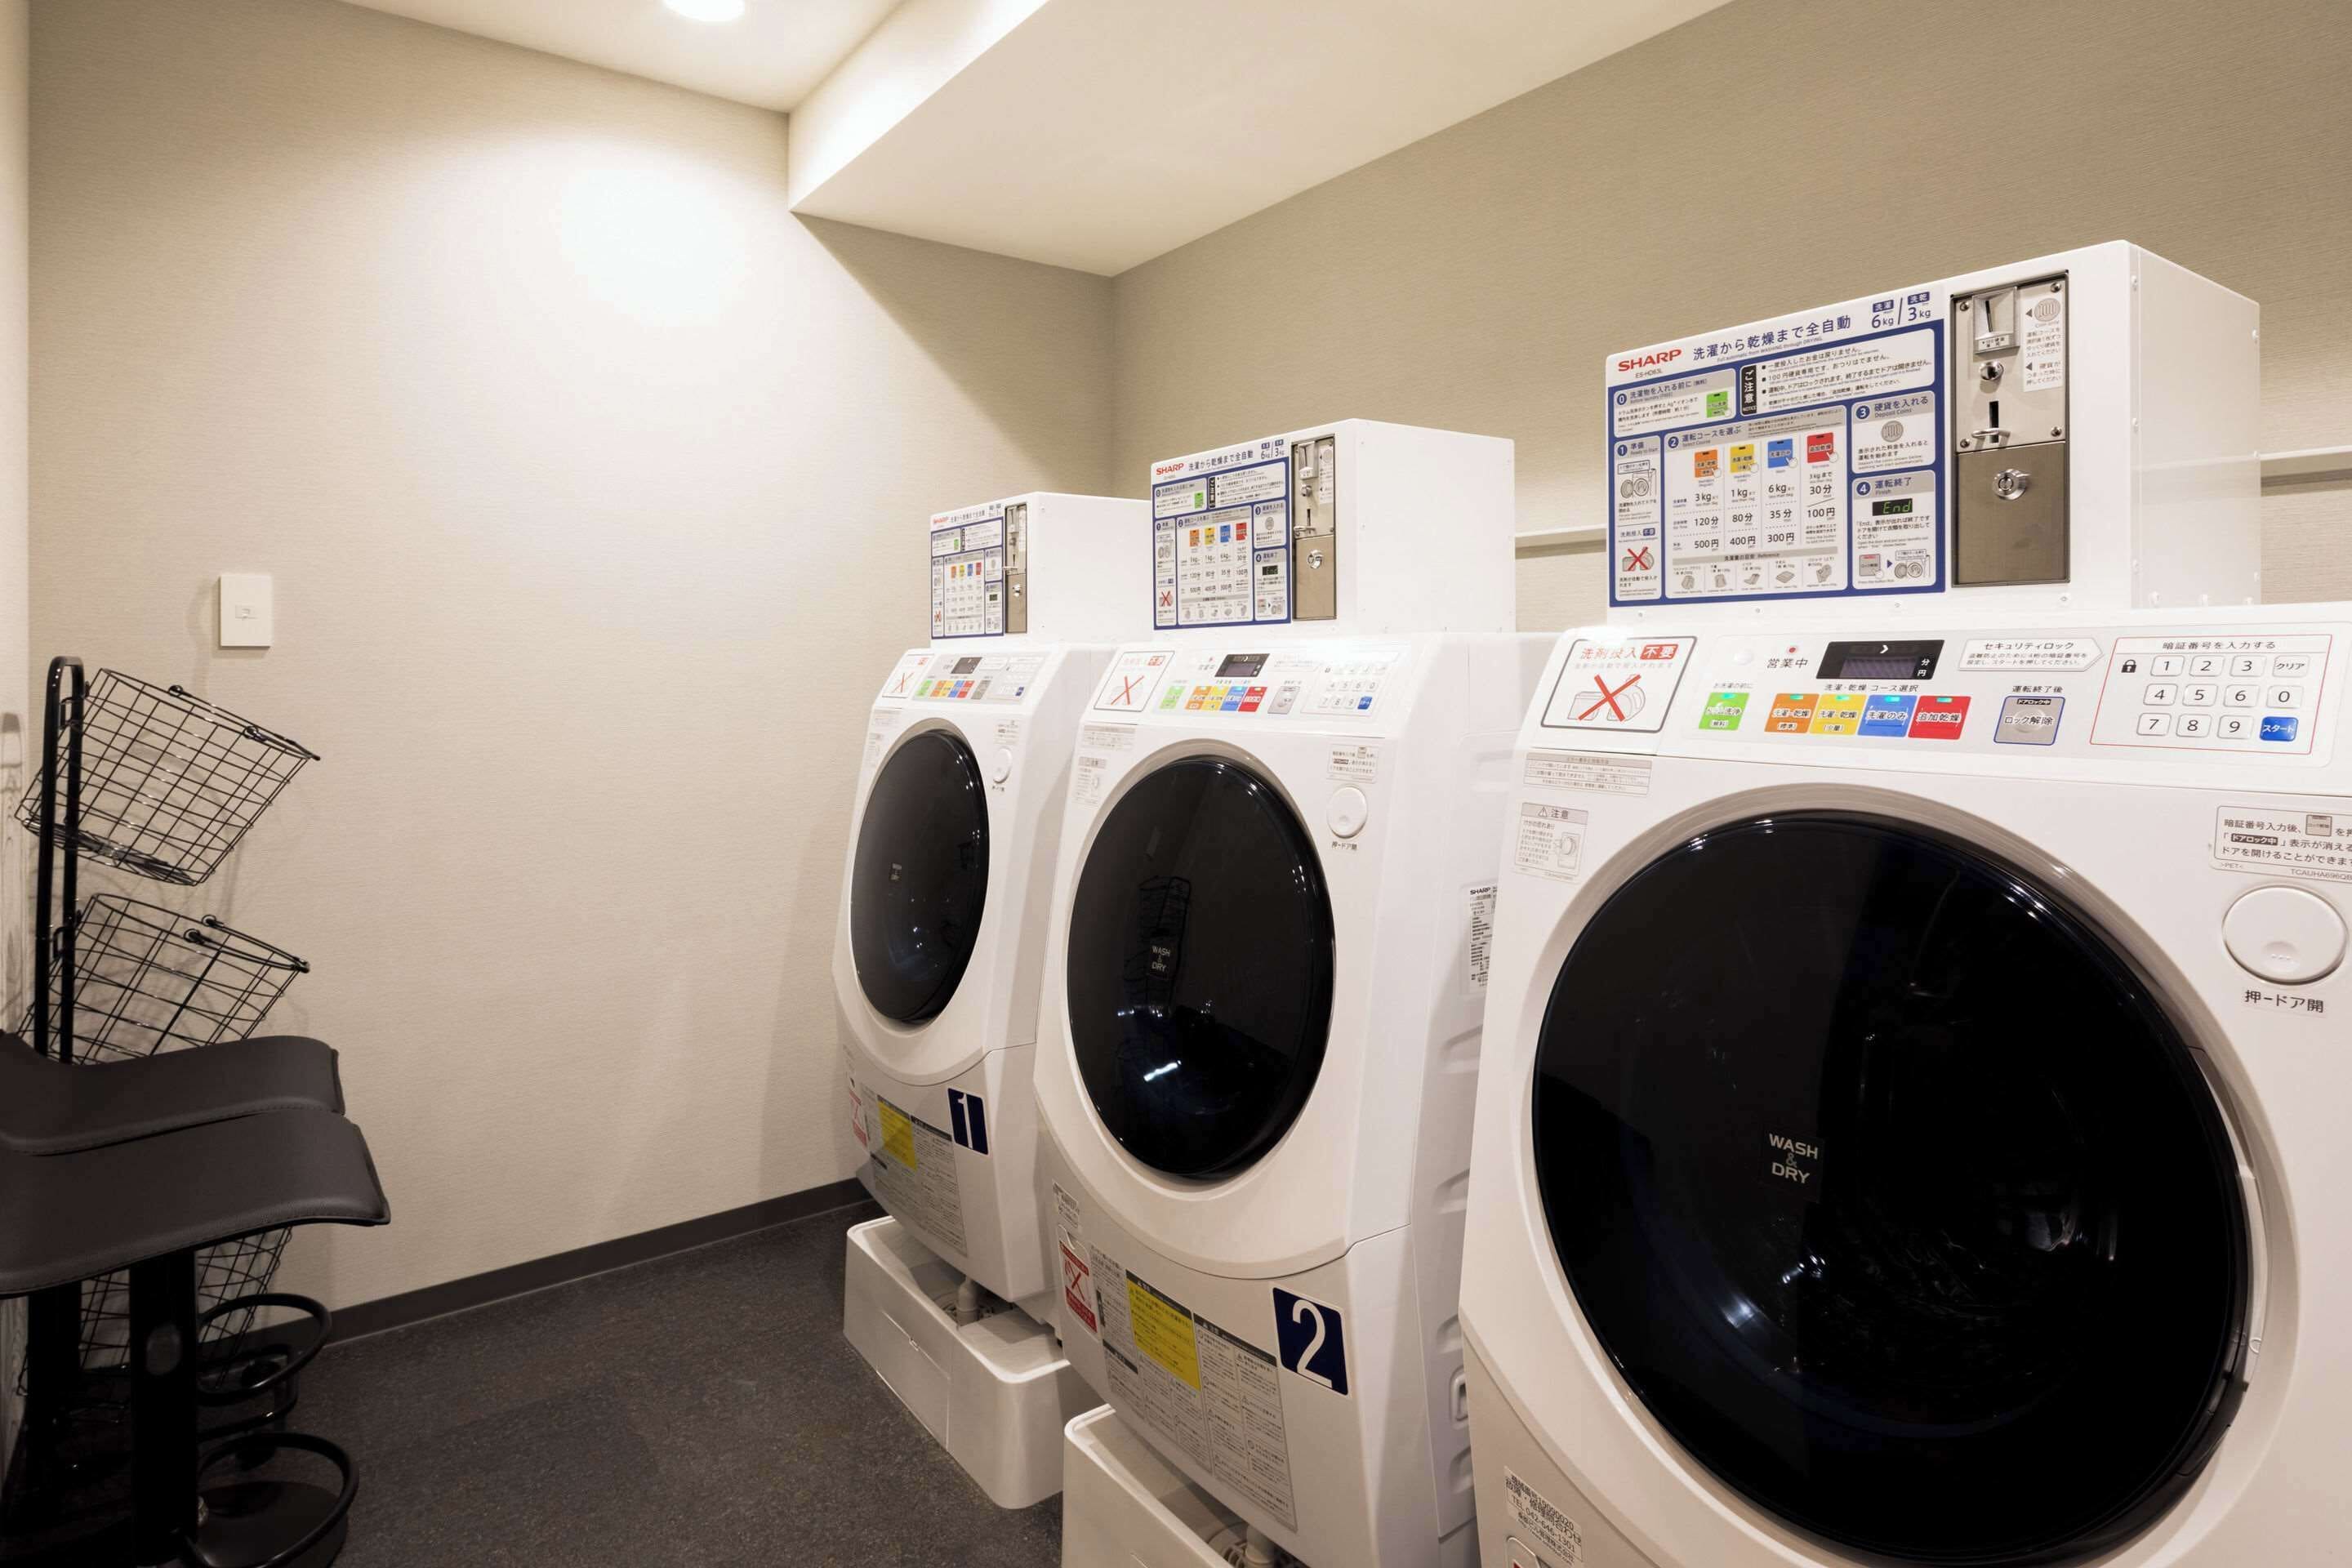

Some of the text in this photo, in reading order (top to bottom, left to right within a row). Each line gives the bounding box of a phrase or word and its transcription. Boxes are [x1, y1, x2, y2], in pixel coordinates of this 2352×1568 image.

[1693, 315, 1851, 361] 洗濯から乾燥まで全自動
[1618, 349, 1682, 372] SHARP
[1744, 369, 1755, 404] ご注意
[1874, 396, 1928, 412] 硬貨を入れる
[1156, 463, 1184, 475] SHARP
[1875, 477, 1912, 488] 運転終了
[1810, 484, 1832, 495] 30分
[1807, 507, 1835, 518] 100円
[1883, 500, 1912, 514] End
[1695, 516, 1718, 526] 120分
[1732, 513, 1753, 523] 80分
[1730, 536, 1755, 546] 400円
[1767, 532, 1794, 542] 300円
[1695, 539, 1718, 549] 500円
[1984, 642, 2074, 650] セキュリティロック
[2163, 641, 2276, 650] 暗証番号を入力する
[1644, 646, 1675, 659] 不要
[1766, 657, 1809, 669] 営業中
[1922, 658, 1930, 666] 分
[2163, 661, 2170, 670] 1
[2201, 661, 2212, 671] 2
[2242, 661, 2252, 671] 3
[1870, 684, 1918, 693] コース選択
[2012, 685, 2063, 693] 運転終了後
[2154, 689, 2290, 702] 4 5 6 0
[1919, 713, 1959, 721] 追加乾燥
[2004, 716, 2054, 725] ロック解除
[2149, 719, 2294, 733] 7 8 9 スタート
[1551, 808, 1569, 820] 注意
[2224, 819, 2301, 833] 暗証番号入力後、
[1470, 887, 1491, 895] SHARP
[1152, 945, 1170, 957] WASH
[958, 1093, 973, 1150] 1
[1769, 1133, 1818, 1160] WASH
[1786, 1152, 1797, 1168] &
[1771, 1162, 1810, 1183] DRY
[1292, 1298, 1333, 1388] 2
